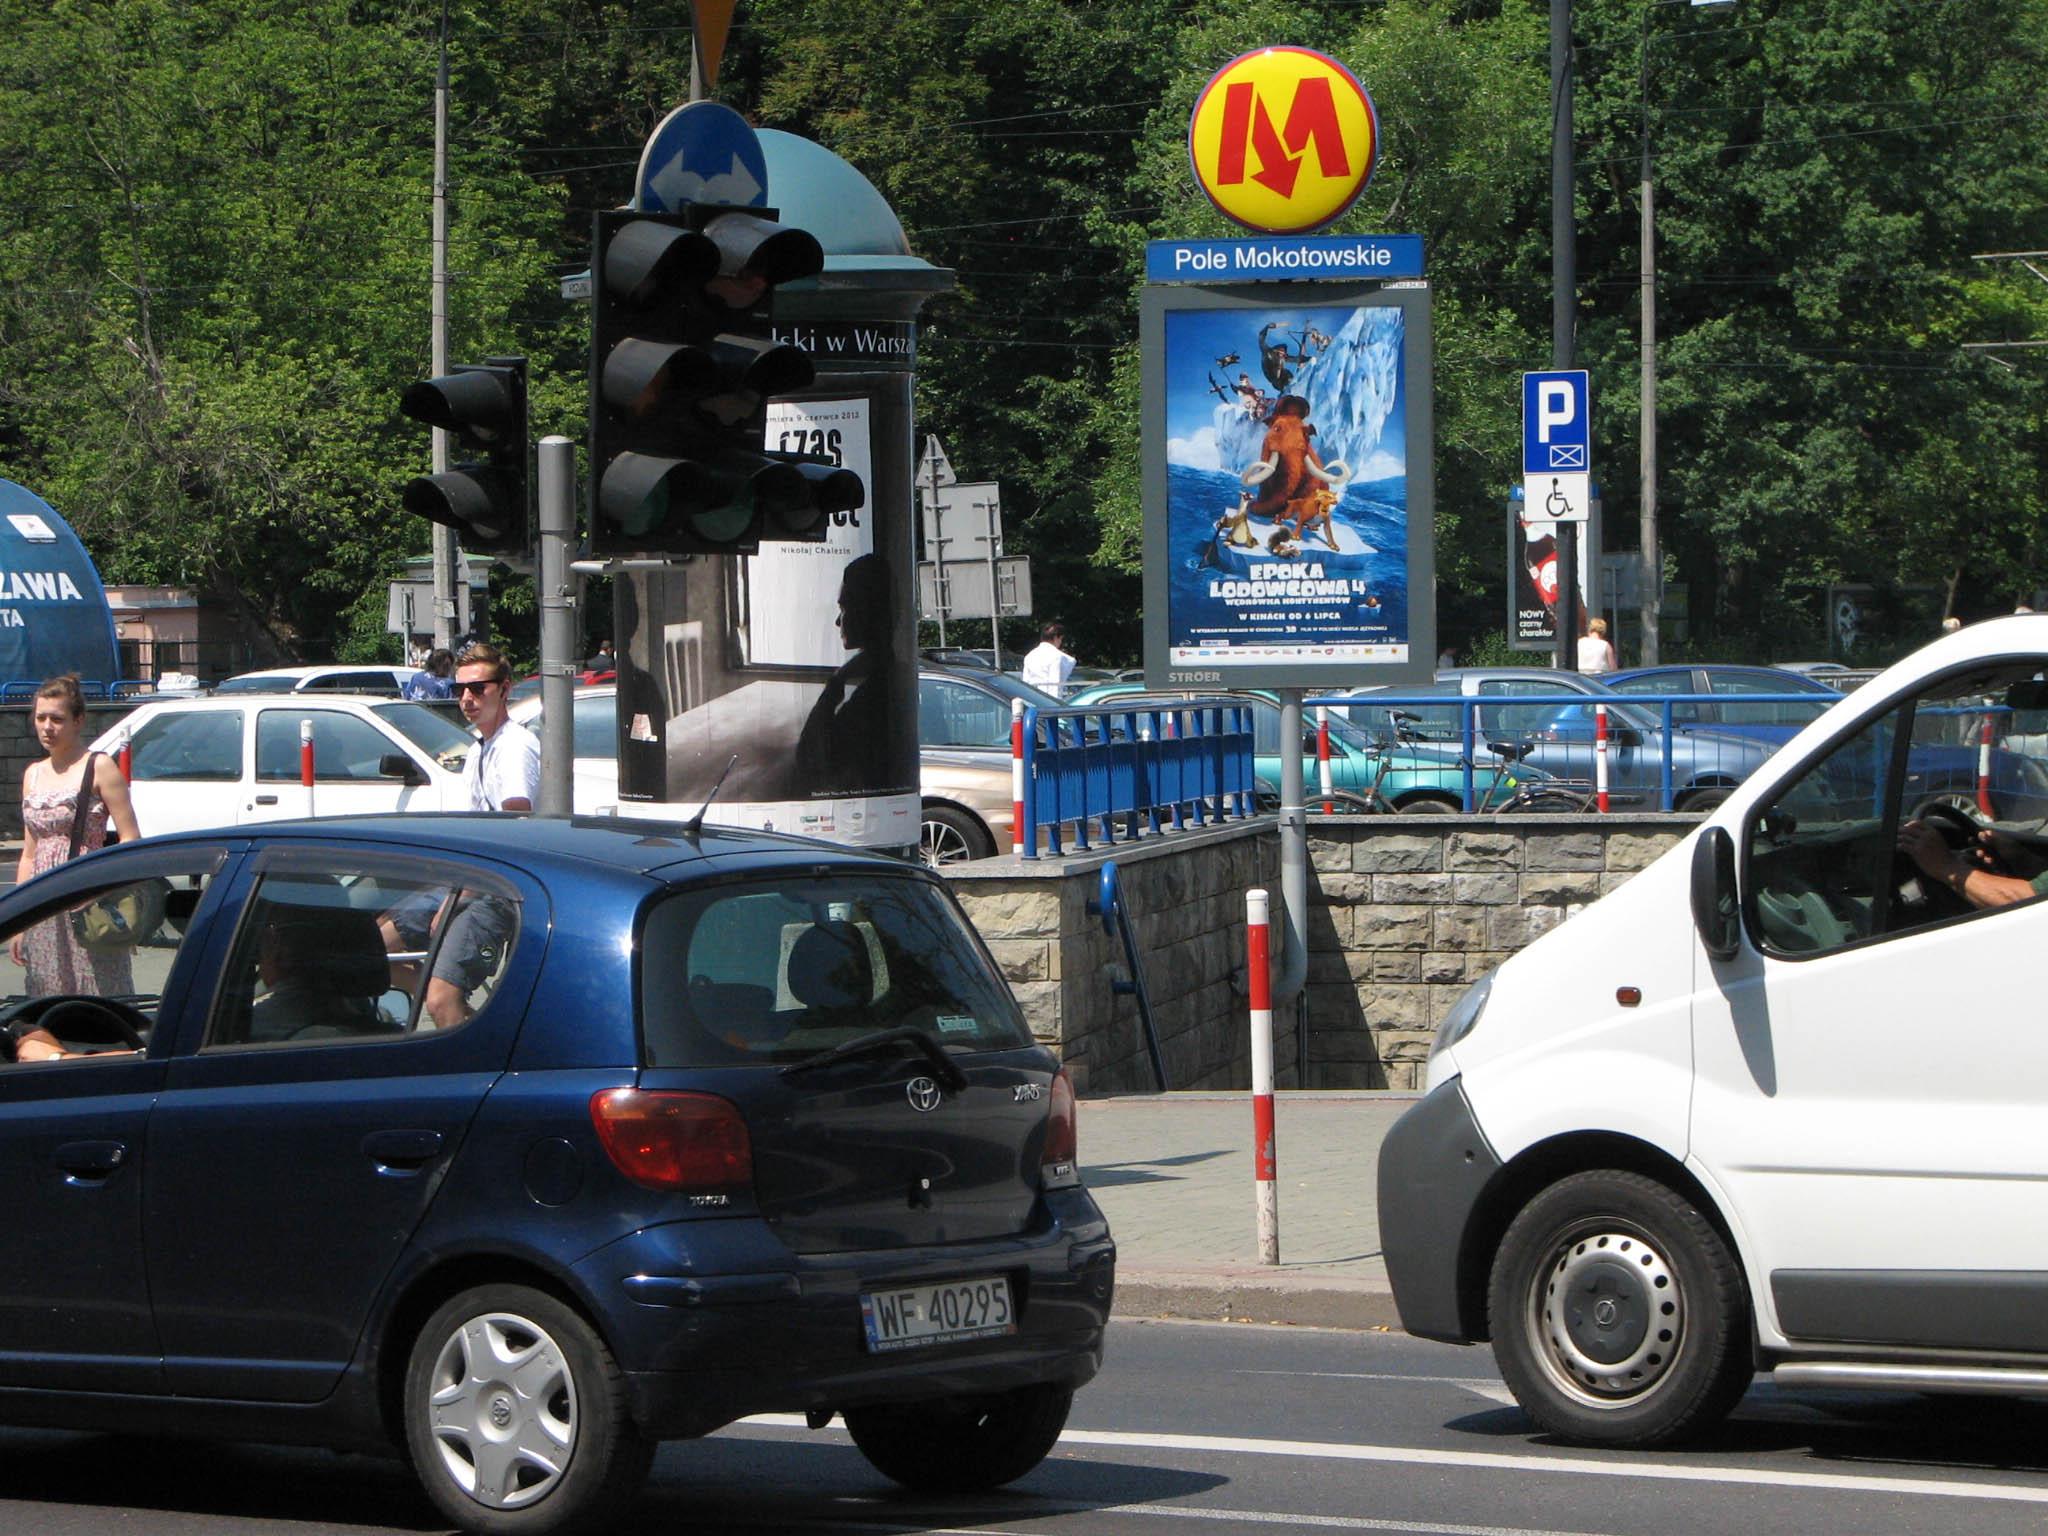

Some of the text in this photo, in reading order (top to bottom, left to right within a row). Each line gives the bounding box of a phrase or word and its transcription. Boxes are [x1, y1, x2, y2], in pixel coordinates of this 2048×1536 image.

[1175, 244, 1392, 270] Pole Mokotowskie
[826, 336, 846, 351] w
[1538, 381, 1575, 443] P
[1250, 563, 1324, 580] EPOKA
[1210, 580, 1366, 598] LODOWCOWA 4
[0, 608, 25, 628] TA
[1250, 612, 1286, 621] KINACH
[1288, 612, 1302, 620] OD
[1305, 612, 1311, 620] 6
[1314, 612, 1341, 620] LIPCA
[1519, 610, 1545, 619] NOWY
[877, 1282, 1008, 1337] WF 40295
